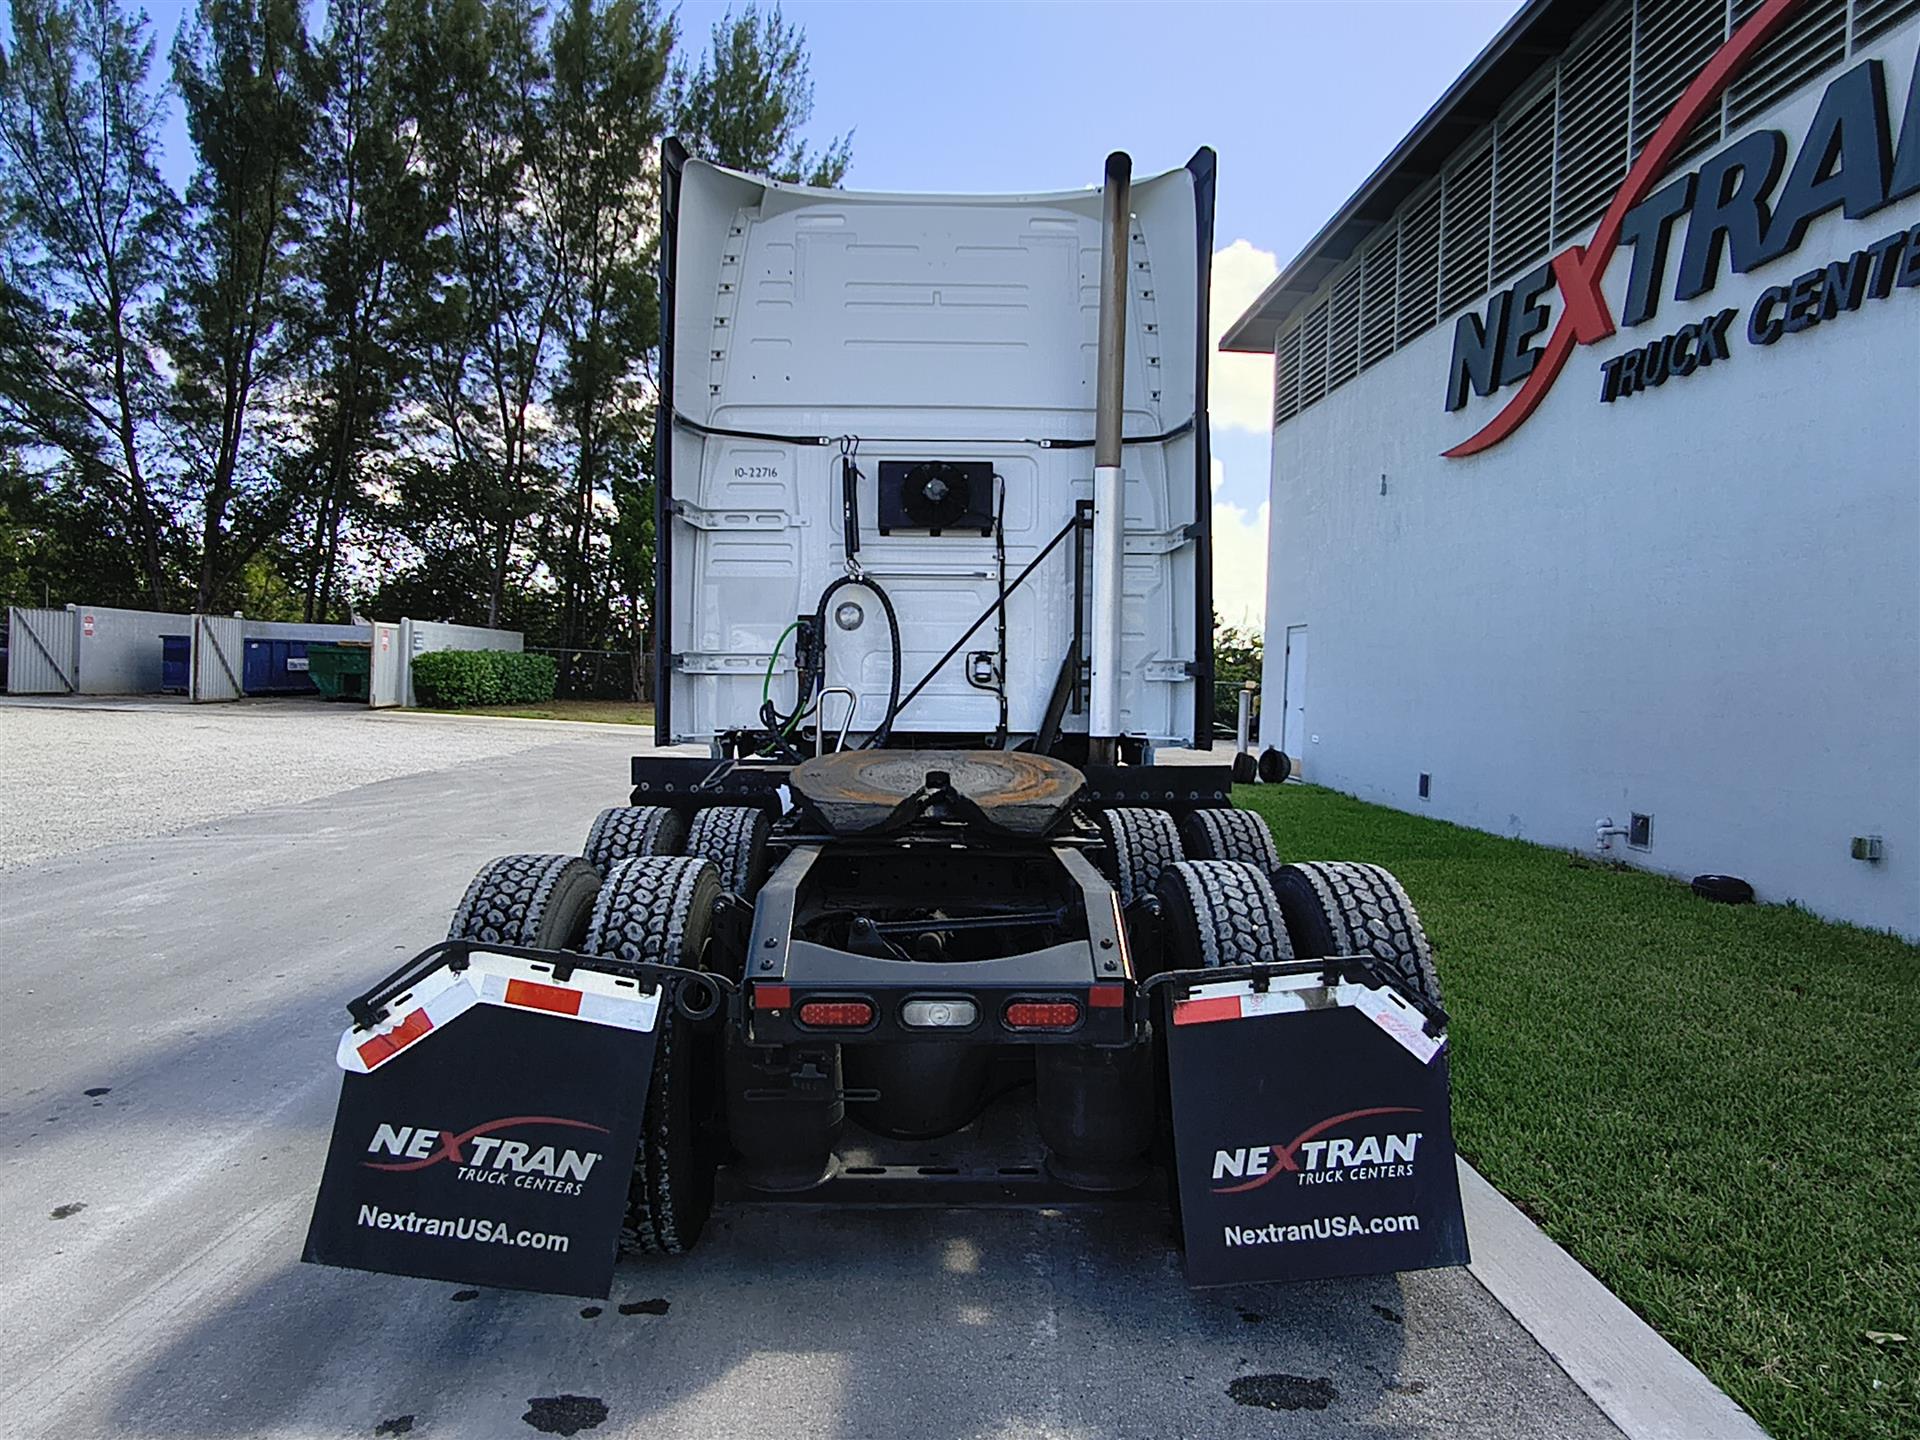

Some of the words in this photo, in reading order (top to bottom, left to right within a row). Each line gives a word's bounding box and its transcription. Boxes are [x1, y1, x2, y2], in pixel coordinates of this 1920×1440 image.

[1445, 30, 1920, 412] NEXTRA
[1599, 308, 1740, 402] TRUCK
[734, 466, 778, 478] 10-22716
[367, 1123, 597, 1182] NEXTRAN
[1211, 1133, 1418, 1179] NEXTRAN
[1298, 1170, 1344, 1186] TRUCK
[1350, 1163, 1414, 1180] CENTERS
[457, 1166, 507, 1186] TRUCK
[514, 1175, 584, 1197] CENTERS
[357, 1203, 569, 1252] NextranUSA.com
[1224, 1214, 1420, 1247] NextranUSA.com
